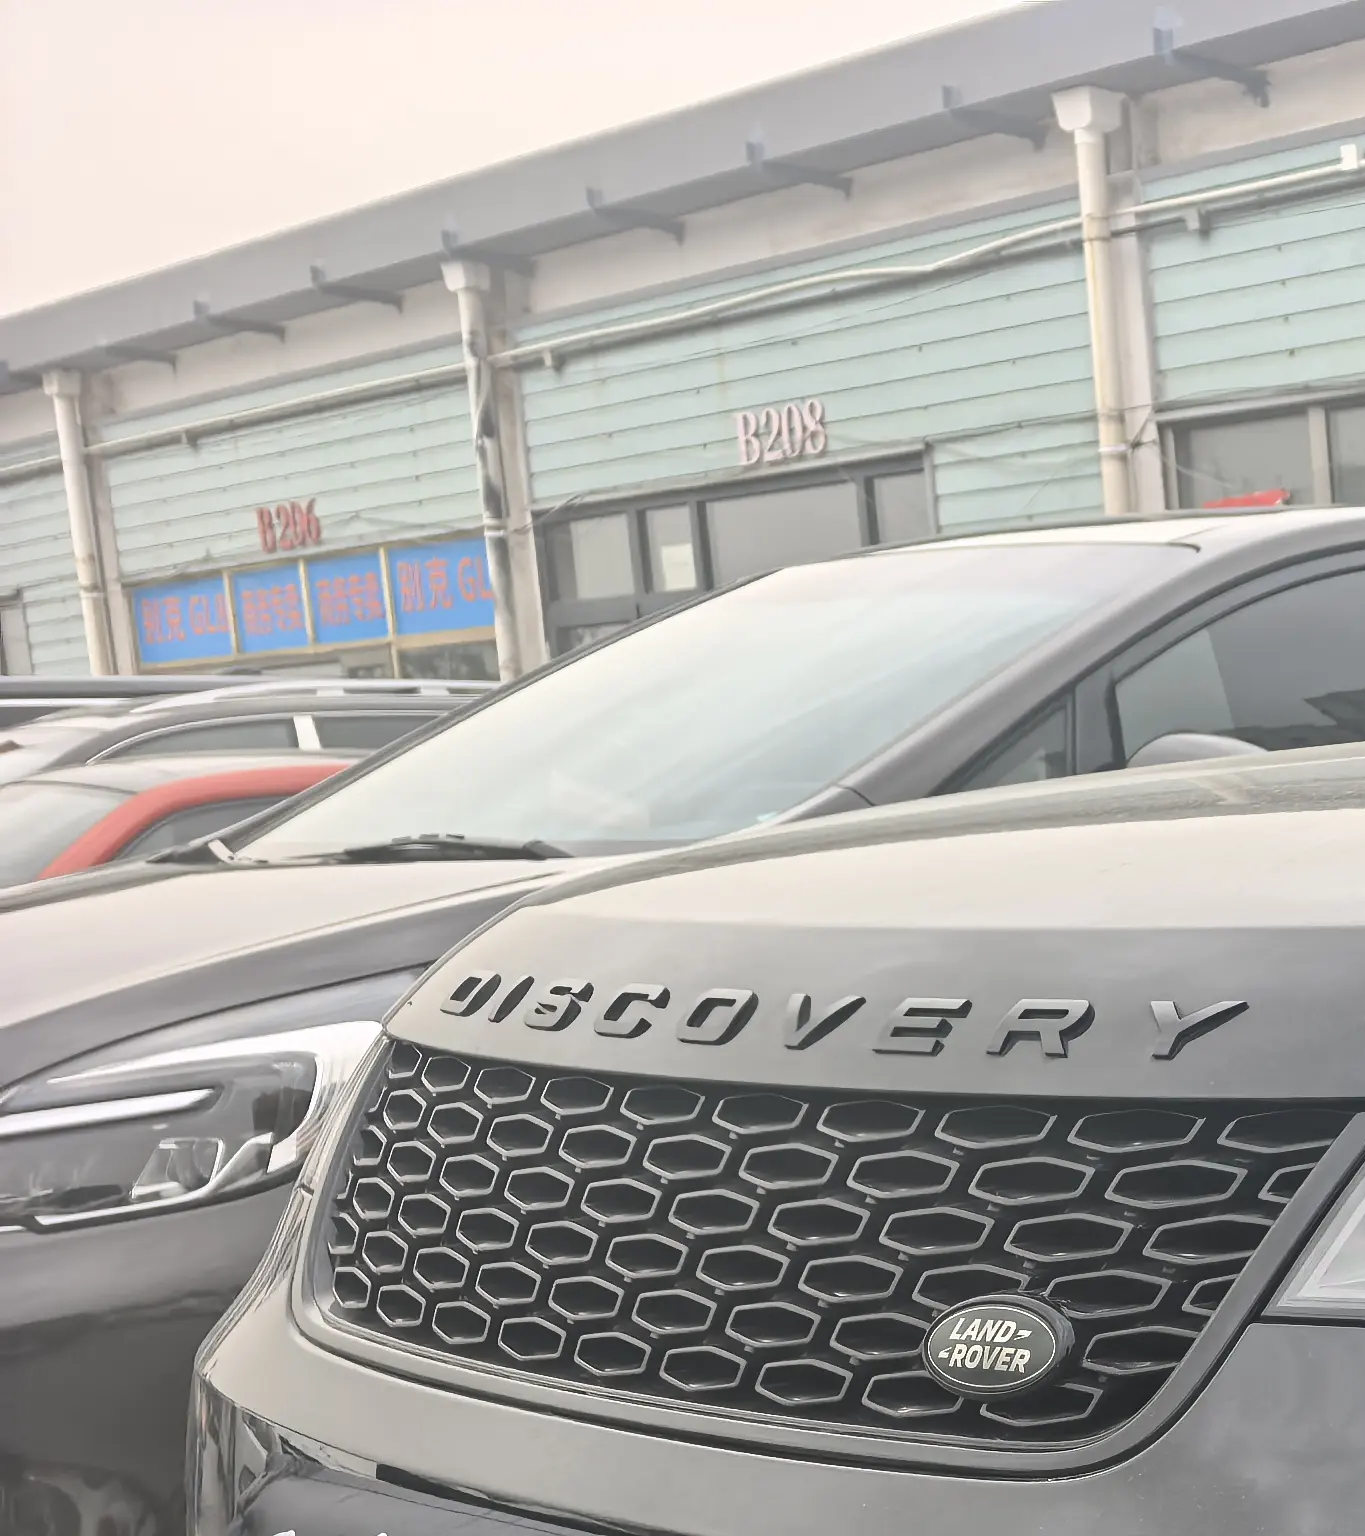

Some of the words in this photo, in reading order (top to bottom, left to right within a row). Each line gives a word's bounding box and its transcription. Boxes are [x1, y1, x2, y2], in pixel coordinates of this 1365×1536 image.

[733, 399, 827, 466] B208
[255, 497, 322, 553] B206
[440, 969, 1249, 1061] DISCOVERY
[948, 1317, 1017, 1343] LAND
[948, 1343, 1031, 1374] ROVER
